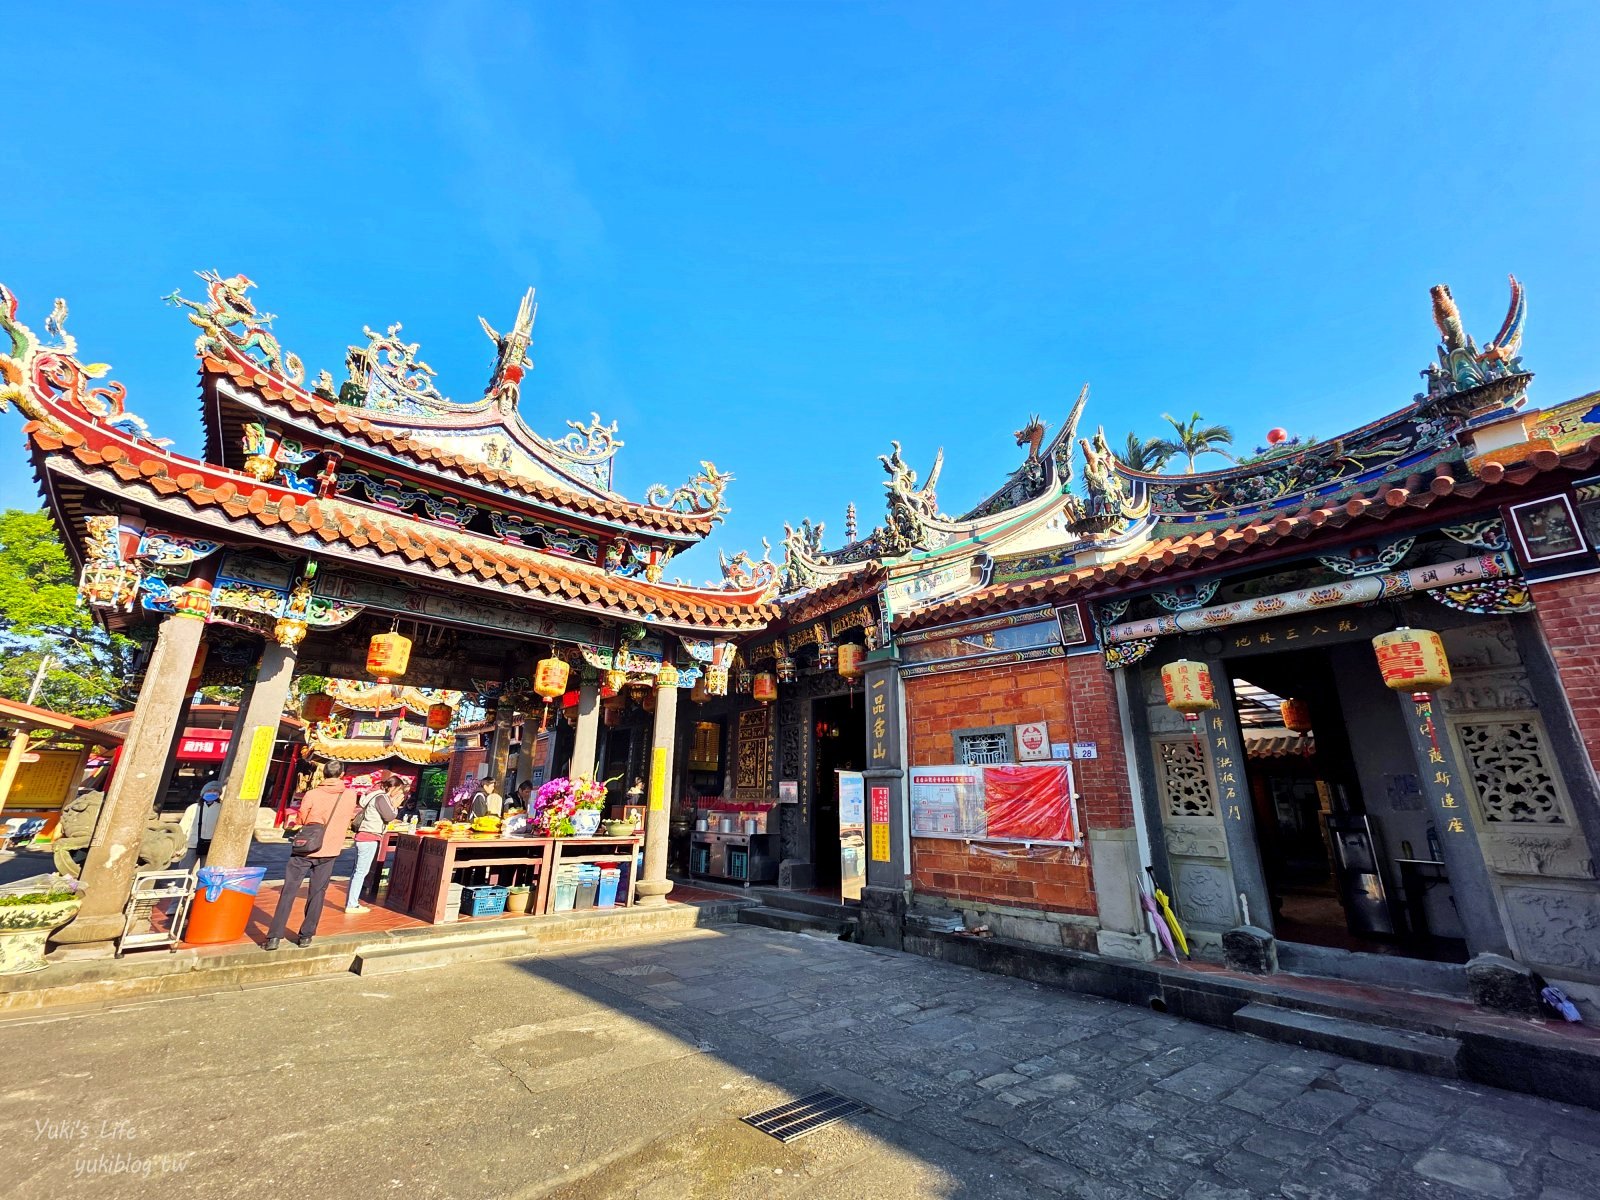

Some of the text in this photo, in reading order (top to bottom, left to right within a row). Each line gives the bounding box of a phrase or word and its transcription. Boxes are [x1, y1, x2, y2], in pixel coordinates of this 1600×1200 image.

[1177, 665, 1194, 701] 國泰民安
[872, 679, 887, 760] 一品名山
[1082, 749, 1092, 758] 28
